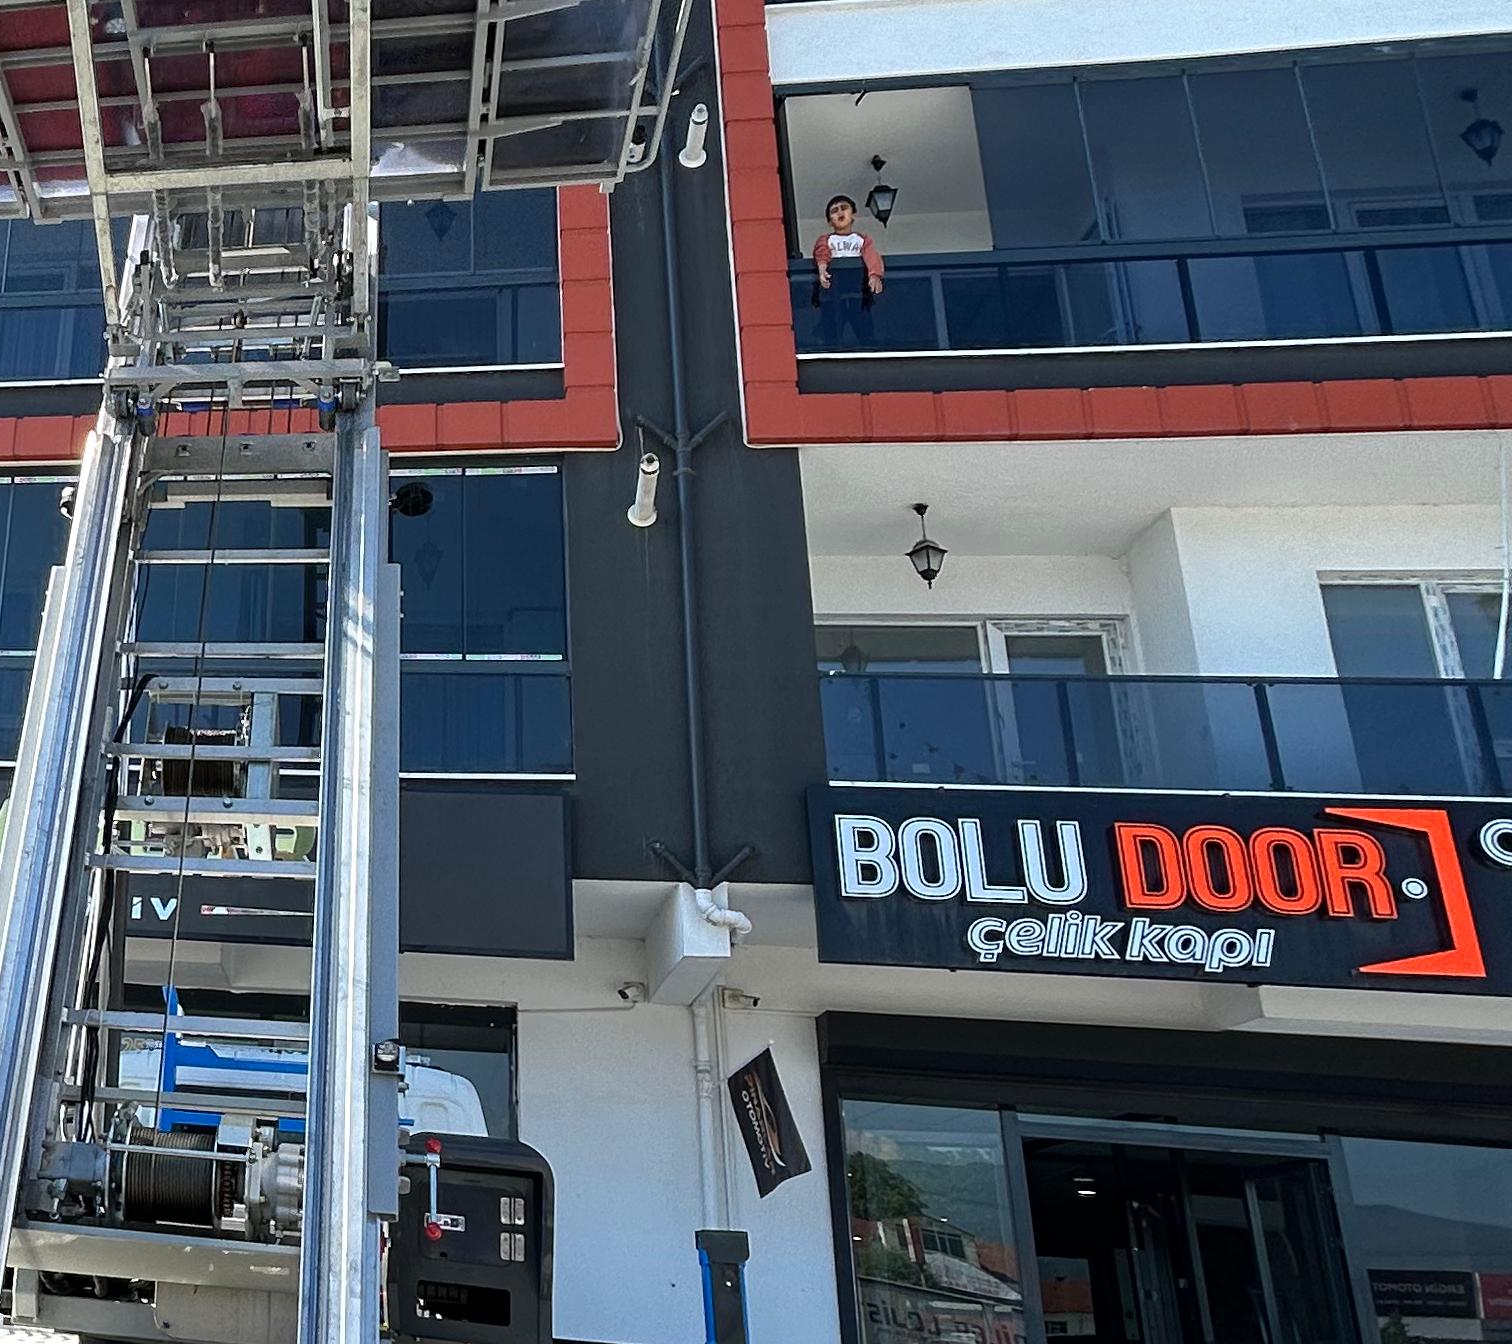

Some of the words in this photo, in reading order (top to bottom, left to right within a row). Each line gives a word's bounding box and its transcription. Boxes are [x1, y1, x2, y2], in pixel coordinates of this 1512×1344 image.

[834, 813, 1088, 906] BOLU
[1114, 821, 1398, 920] DOOR
[967, 910, 1121, 963] çelik
[1124, 915, 1276, 974] kapı
